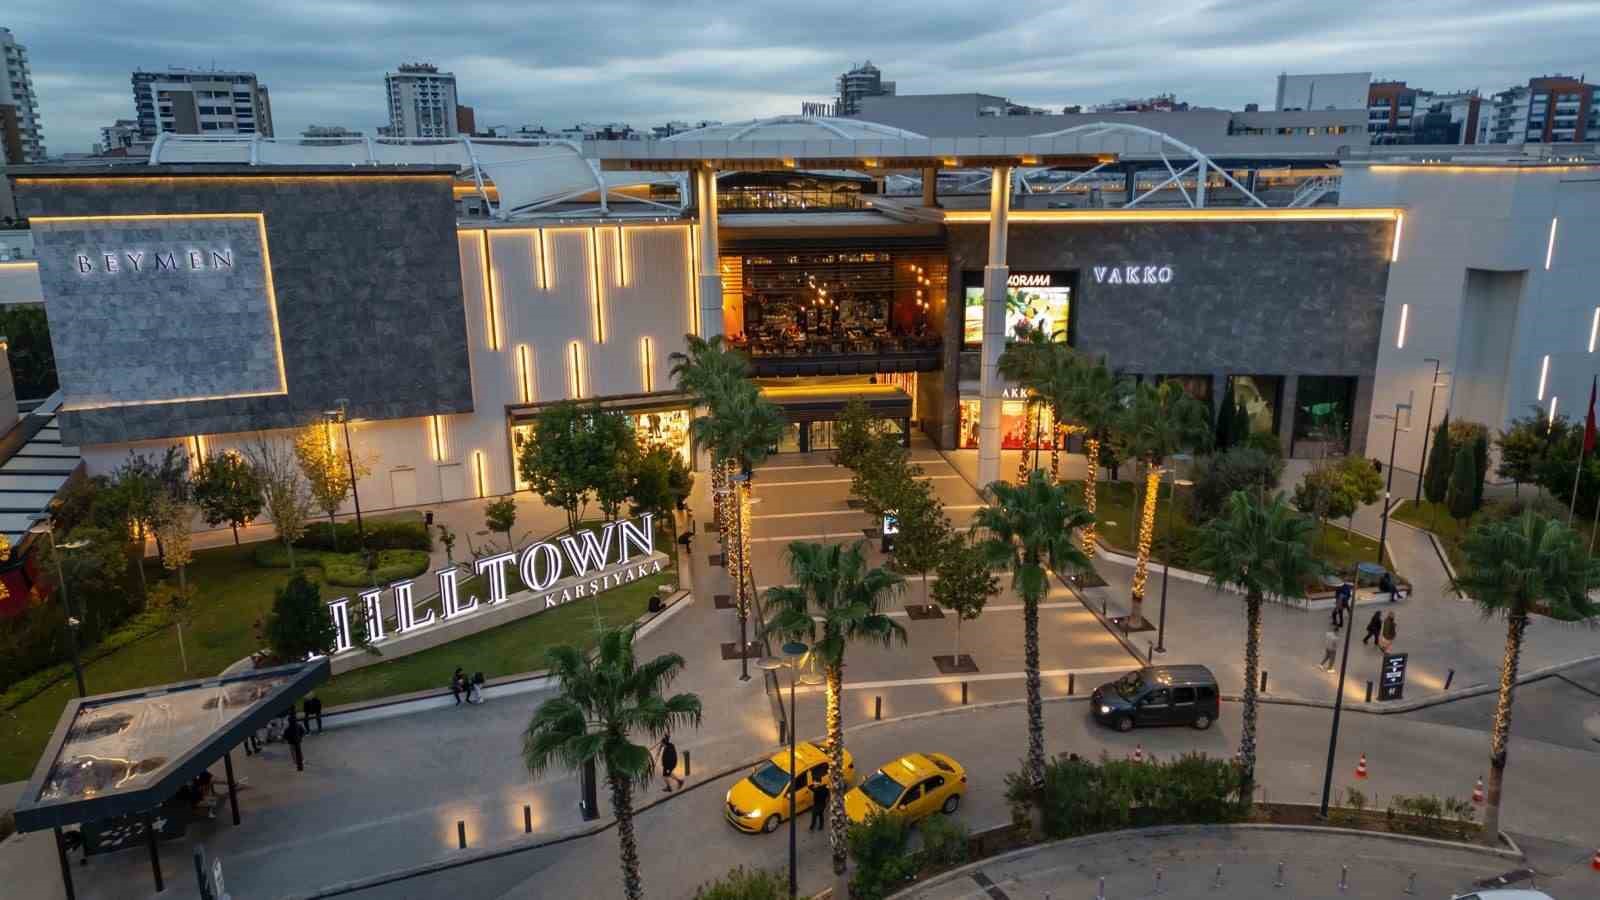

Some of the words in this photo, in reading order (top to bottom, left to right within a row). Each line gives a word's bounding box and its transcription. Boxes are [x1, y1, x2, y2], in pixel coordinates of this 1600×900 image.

[77, 250, 234, 274] BEYMEN
[1093, 265, 1173, 284] VAKKO
[545, 560, 661, 609] KARŞIYAKA
